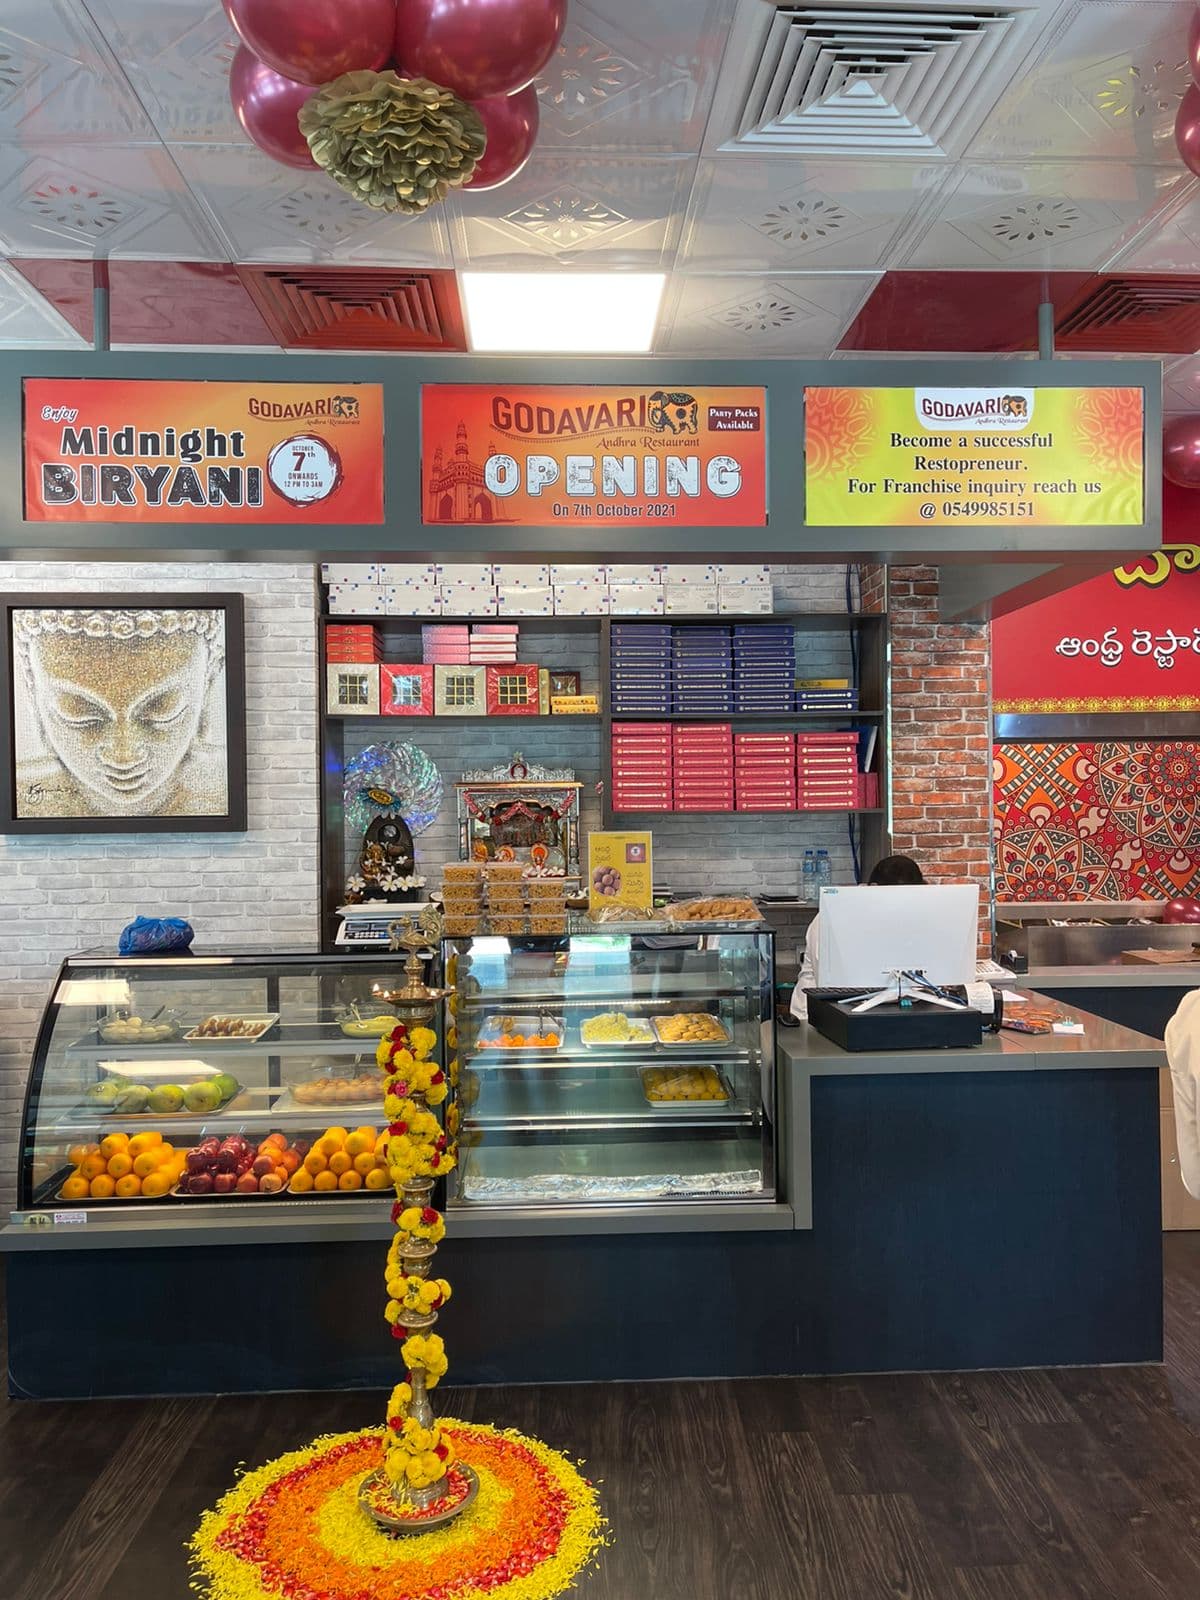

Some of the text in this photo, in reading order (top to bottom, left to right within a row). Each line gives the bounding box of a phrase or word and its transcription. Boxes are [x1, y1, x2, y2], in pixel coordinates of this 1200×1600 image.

[41, 406, 78, 422] Enjoy
[248, 397, 331, 418] GODAVARI
[492, 395, 645, 434] GODAVARI
[735, 408, 758, 417] Packs
[921, 397, 1001, 417] GODAVARI
[716, 420, 754, 429] Available
[61, 427, 244, 462] Midnight
[596, 436, 700, 451] Andhra Restaurant
[890, 433, 1053, 448] Become a successful
[914, 456, 1028, 473] Restopreneur.
[484, 454, 742, 497] OPENING
[42, 463, 263, 507] BIRYANI
[847, 479, 1101, 497] For Franchise inquiry reach us
[553, 504, 676, 517] On 7th October 2021
[919, 502, 1035, 518] @ 0549985151
[1055, 627, 1123, 666] ఆంధ్ర
